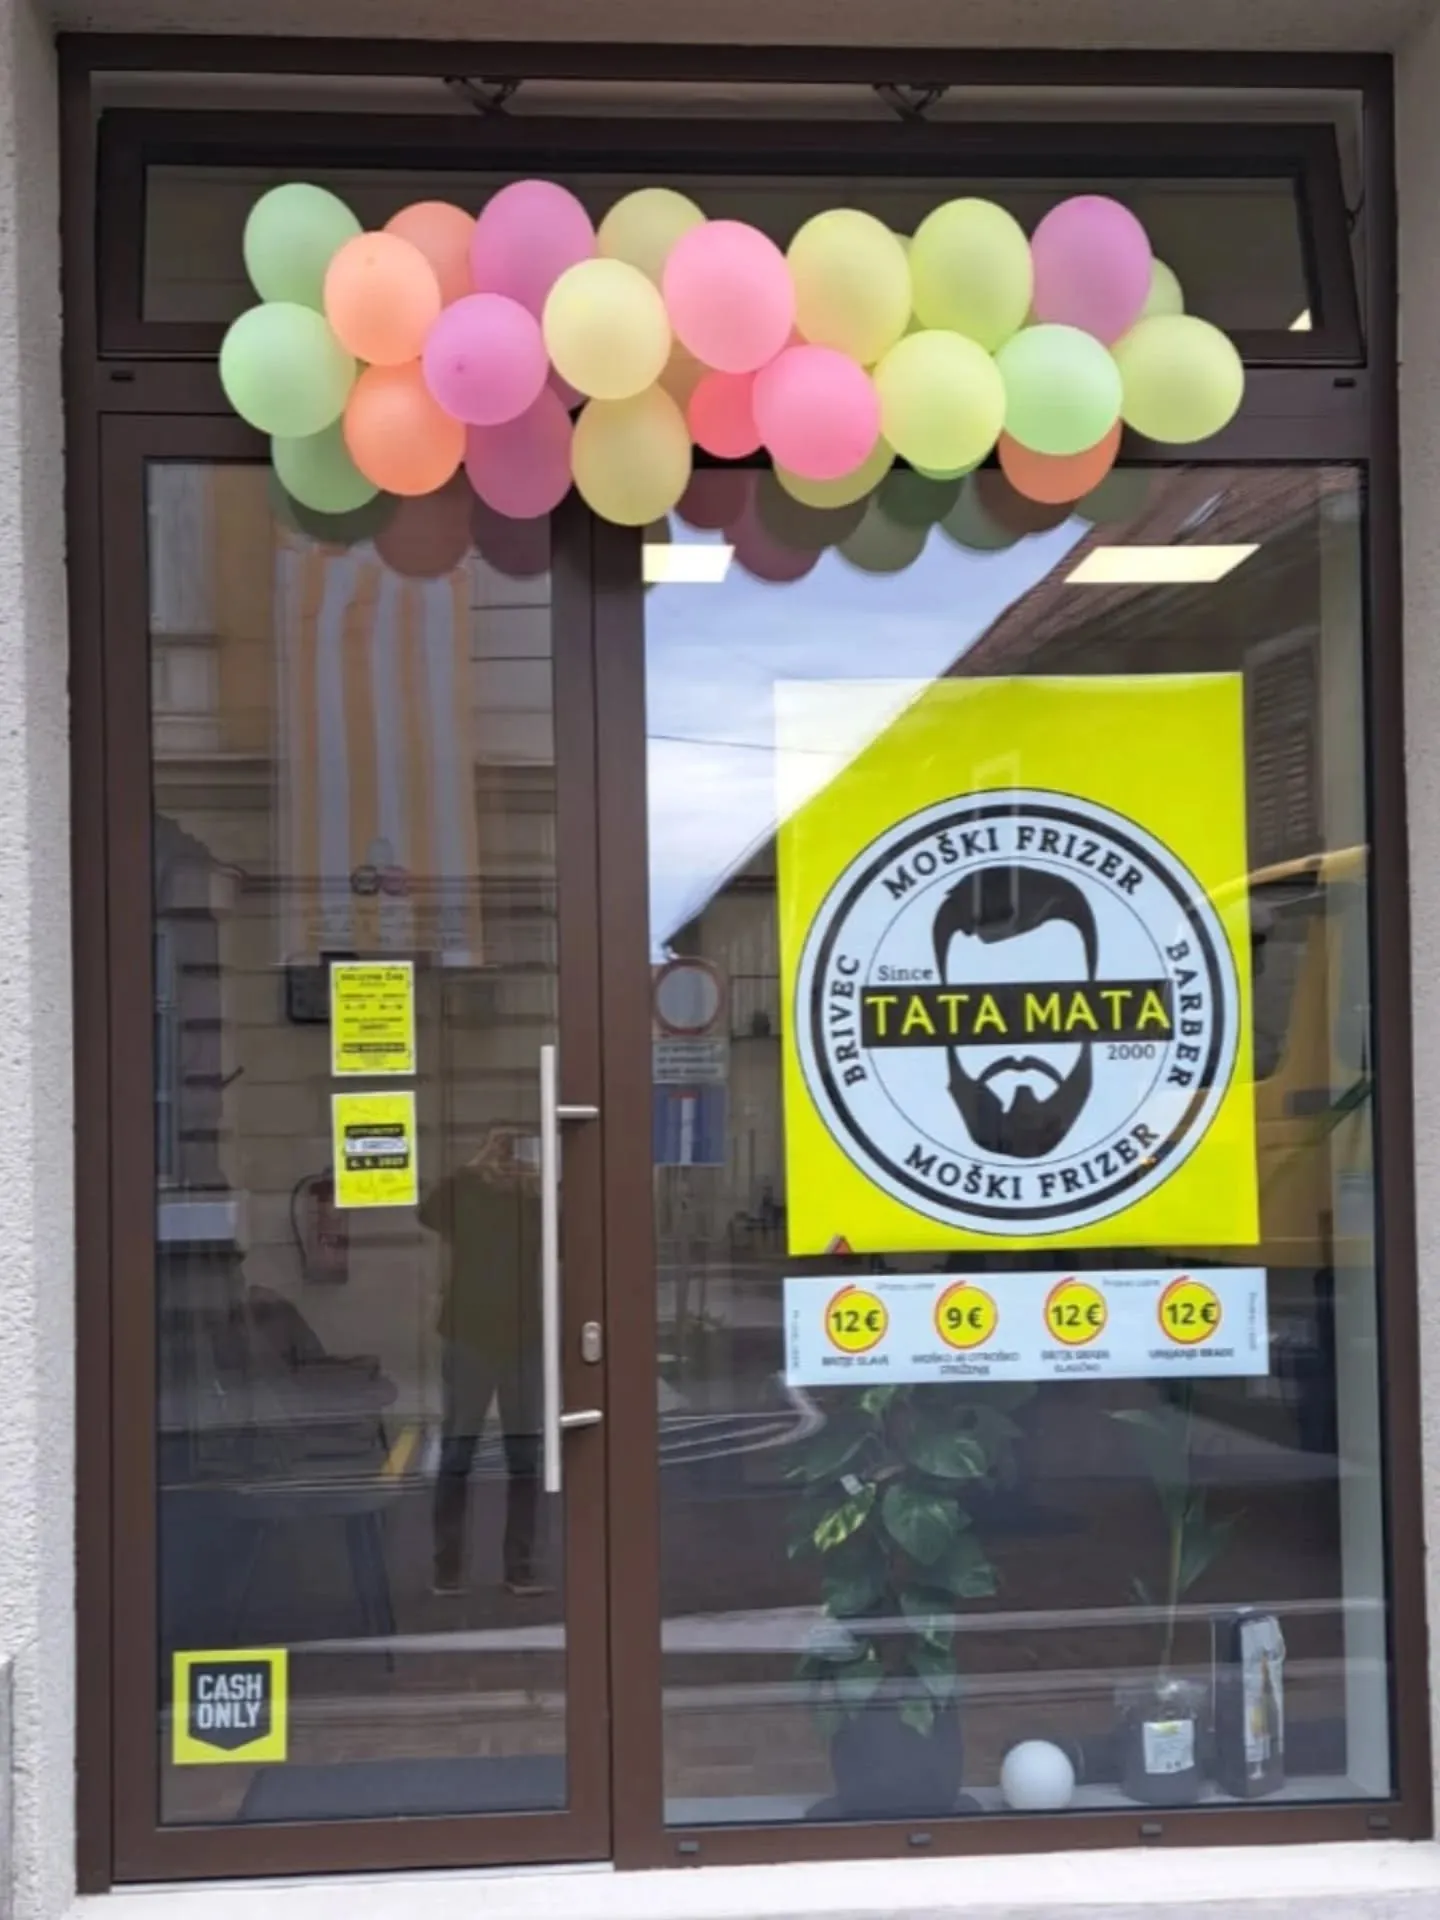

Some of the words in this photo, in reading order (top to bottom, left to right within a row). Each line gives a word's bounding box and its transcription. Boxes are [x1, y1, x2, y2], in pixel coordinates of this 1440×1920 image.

[881, 828, 999, 901] MOŠKI
[1016, 826, 1144, 896] FRIZER
[877, 965, 933, 982] Since
[830, 955, 867, 1086] BRIVEC
[866, 993, 1008, 1036] TATA
[1025, 989, 1171, 1033] MATA
[1166, 941, 1204, 1089] BARBER
[1107, 1044, 1155, 1061] 2000
[904, 1144, 1023, 1200] MOŠKI
[1039, 1122, 1160, 1199] FRIZER
[197, 1673, 262, 1701] CASH
[197, 1701, 261, 1729] ONLY
